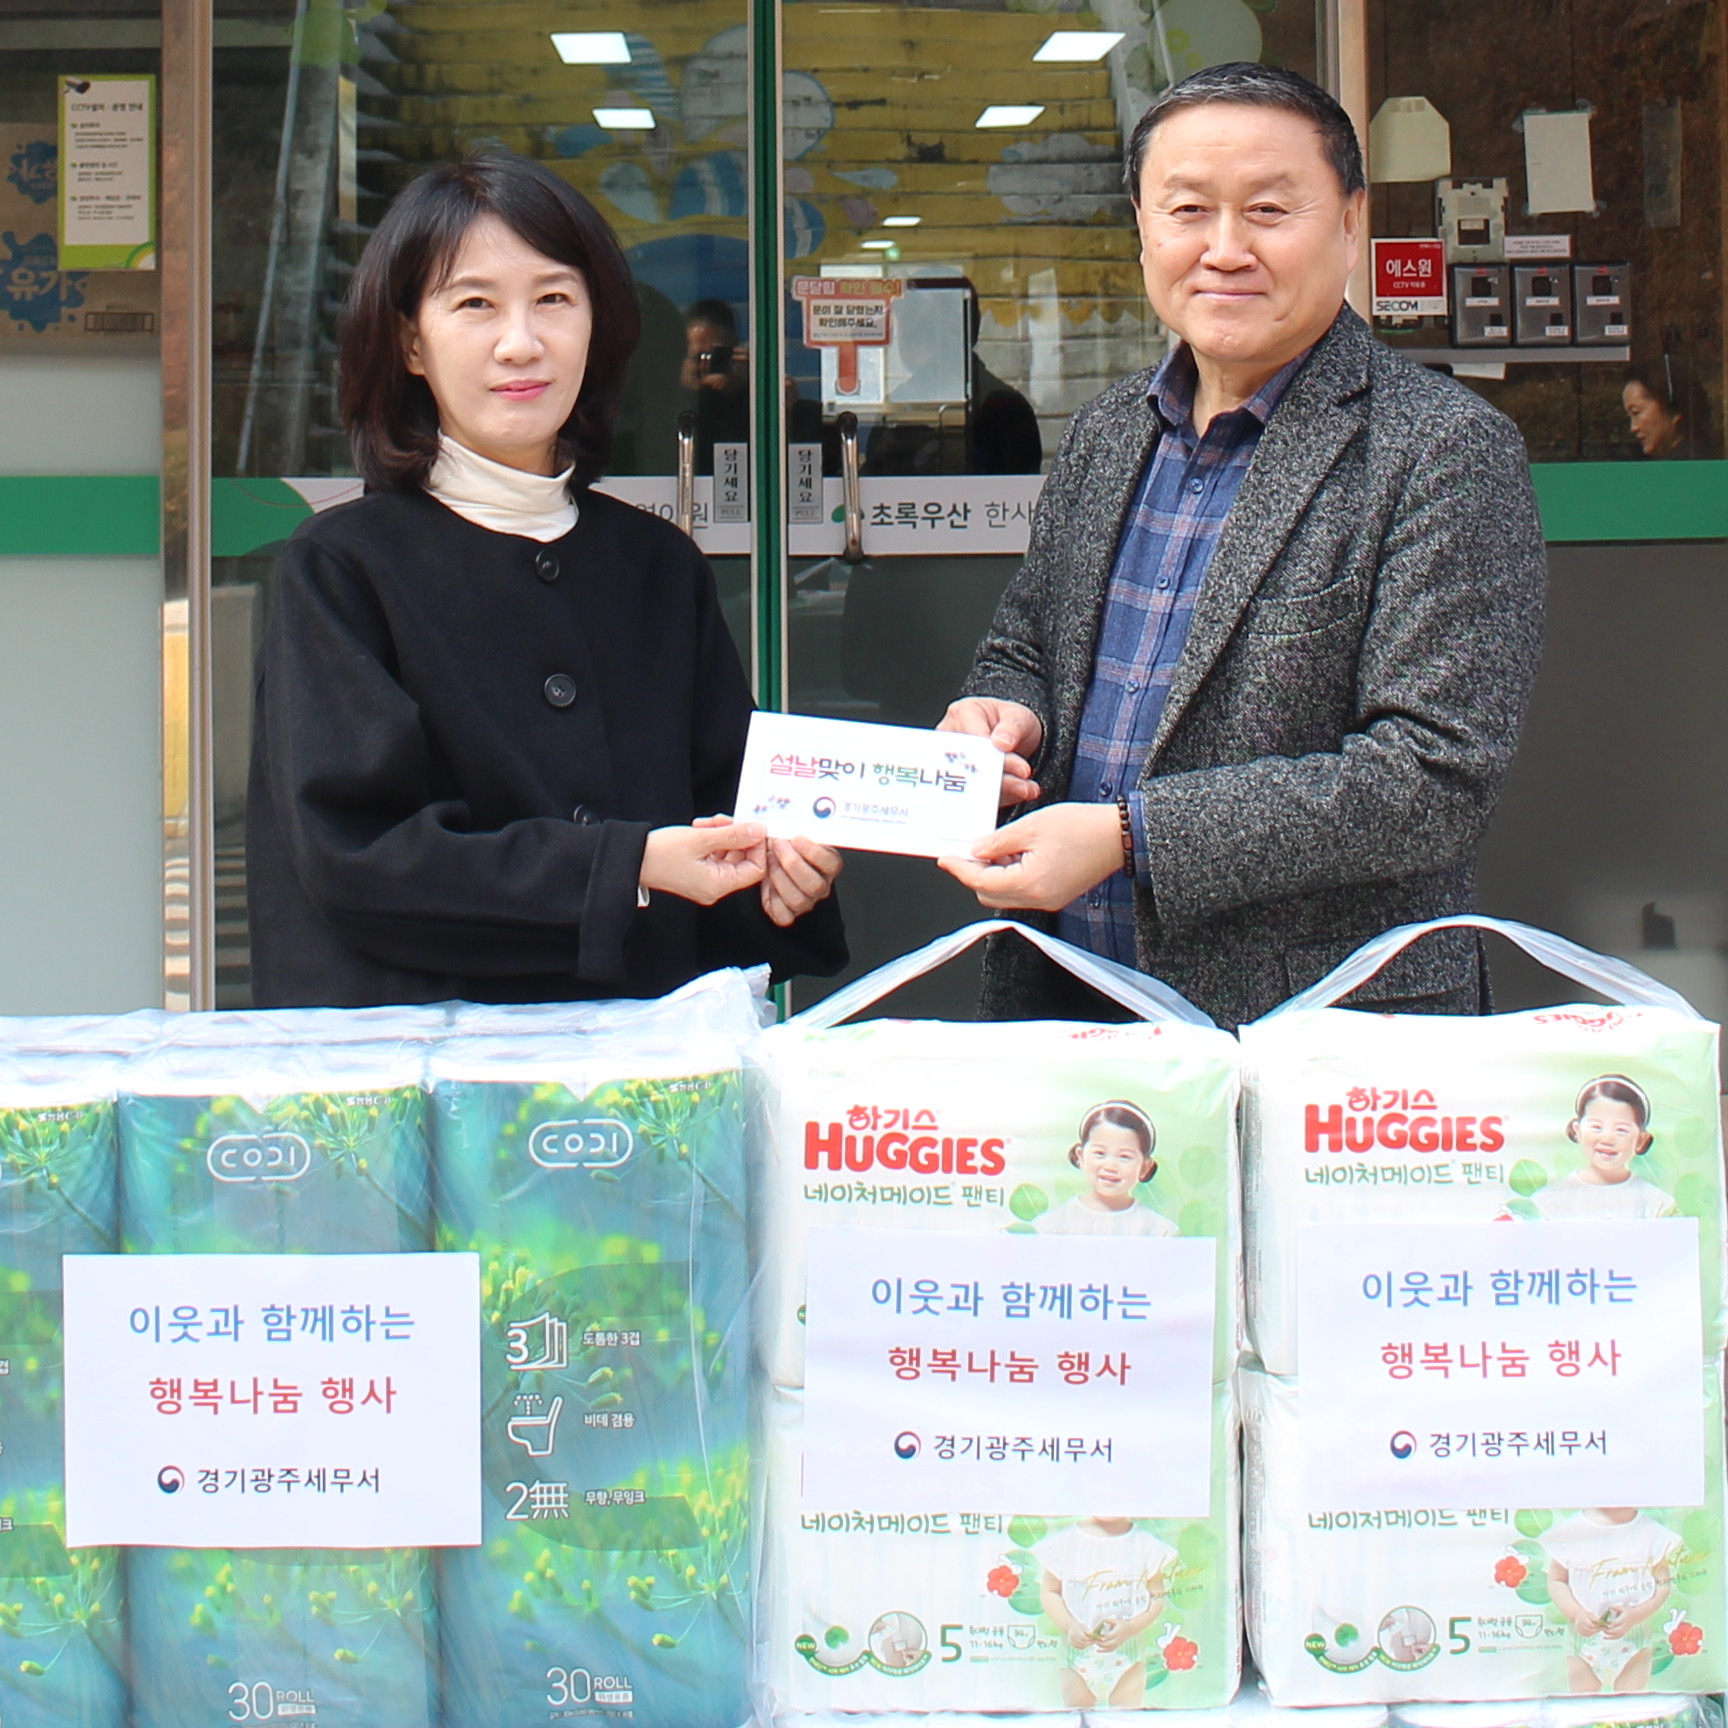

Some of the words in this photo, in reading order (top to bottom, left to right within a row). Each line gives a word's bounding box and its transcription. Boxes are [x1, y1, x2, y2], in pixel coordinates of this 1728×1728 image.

[1385, 258, 1432, 278] 에스원
[1375, 300, 1419, 312] SECOM
[723, 448, 740, 503] 당기세요
[797, 448, 813, 503] 당기세요
[870, 501, 972, 530] 초록우산
[769, 752, 866, 780] 설날맞이
[872, 761, 968, 794] 행복나눔
[846, 1104, 940, 1131] 하기스
[1345, 1086, 1439, 1112] 하기스
[1304, 1103, 1506, 1153] HUGGIES
[803, 1120, 1006, 1176] HUGGIES
[1304, 1161, 1454, 1186] 네이처메이드
[1461, 1162, 1504, 1185] 팬티
[803, 1181, 954, 1206] 네이처메이드
[961, 1184, 1005, 1208] 팬티
[871, 1276, 985, 1318] 이웃과
[1001, 1281, 1152, 1321] 함께하는
[1362, 1270, 1474, 1308] 이웃과
[1489, 1267, 1638, 1306] 함께하는
[129, 1303, 245, 1344] 이웃과
[260, 1303, 416, 1343] 함께하는
[583, 1332, 619, 1346] 도톰한
[621, 1331, 641, 1346] 3겹
[887, 1346, 1040, 1384] 행복나눔
[1056, 1351, 1132, 1386] 행사
[1380, 1340, 1531, 1380] 행복나눔
[1547, 1338, 1623, 1377] 행사
[148, 1376, 304, 1416] 행복나눔
[320, 1375, 398, 1415] 행사
[584, 1413, 609, 1428] 비데
[611, 1413, 635, 1428] 겸용
[932, 1434, 1114, 1464] 경기광주세무서
[1428, 1429, 1608, 1458] 경기광주세무서
[197, 1466, 381, 1494] 경기광주세무서
[800, 1510, 953, 1535] 네이처메이드
[959, 1514, 1003, 1535] 팬티
[940, 1624, 964, 1663] 5
[1448, 1616, 1472, 1655] 5
[227, 1681, 274, 1721] 30
[275, 1690, 315, 1703] ROLL
[546, 1666, 591, 1706] 30
[593, 1675, 633, 1690] ROLL
